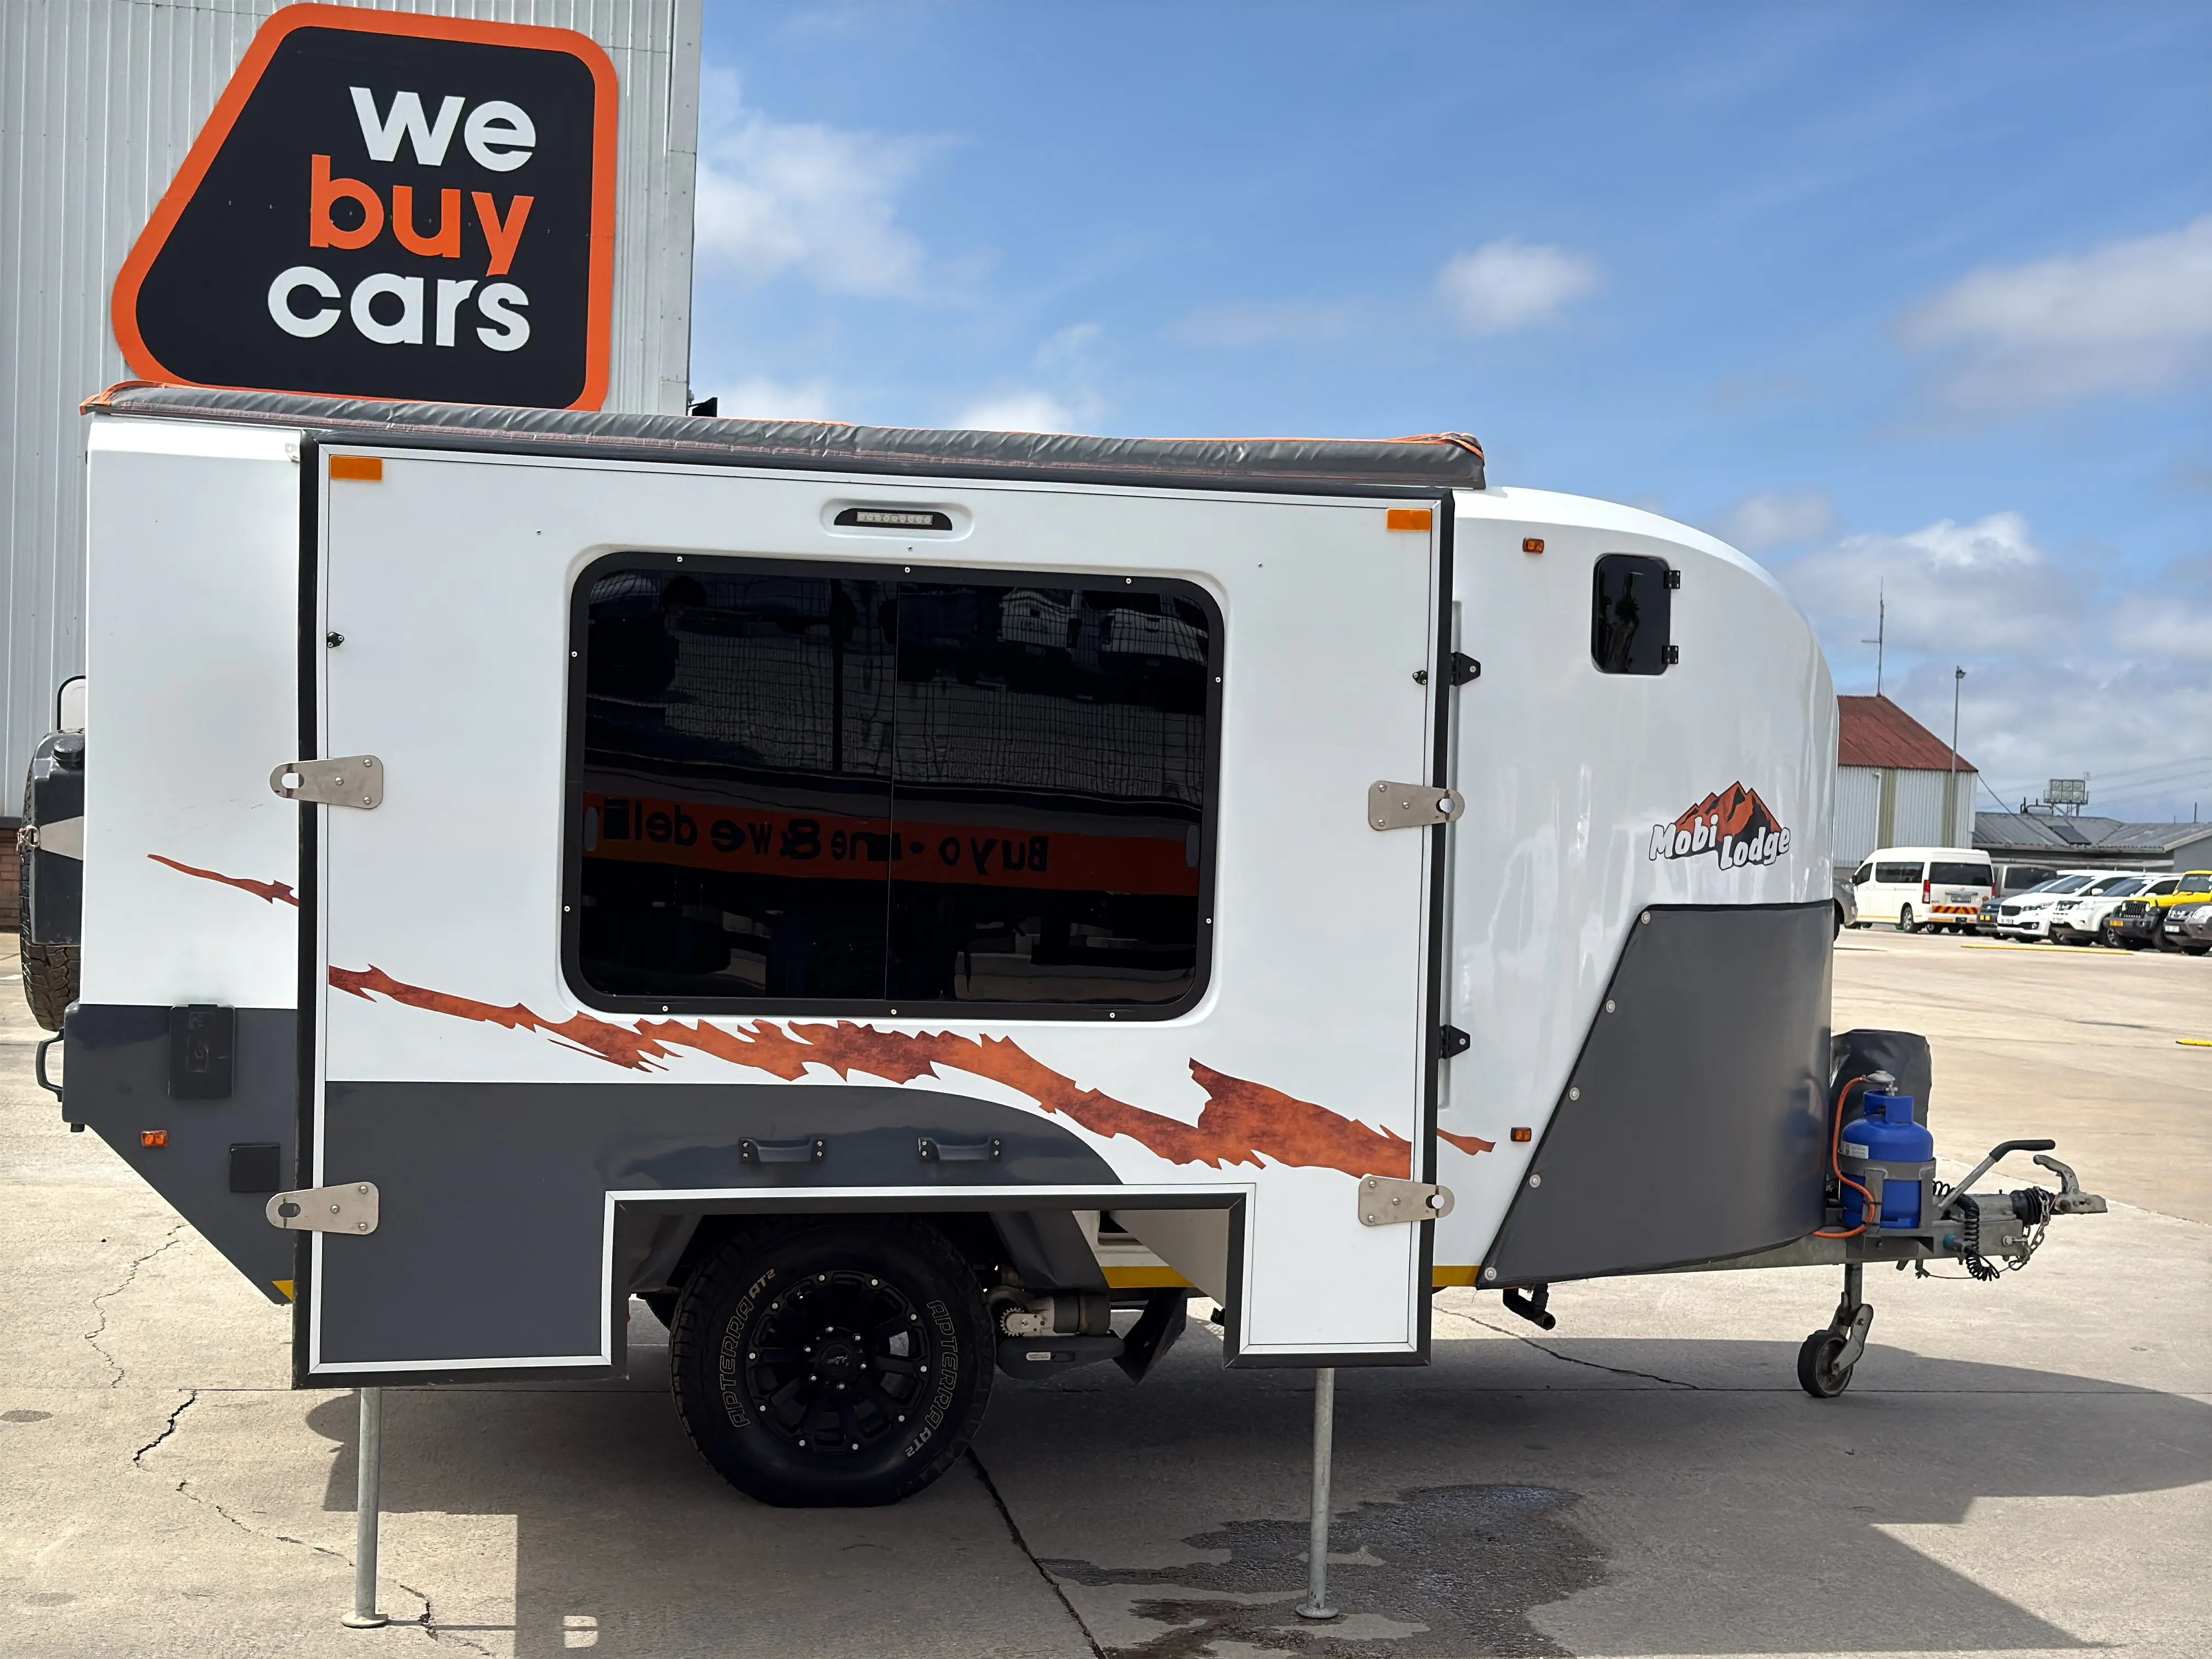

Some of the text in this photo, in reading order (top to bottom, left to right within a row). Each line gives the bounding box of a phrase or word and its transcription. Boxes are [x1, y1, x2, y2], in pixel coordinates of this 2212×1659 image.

[349, 86, 536, 172] we
[309, 154, 534, 276] buy
[268, 266, 530, 352] cars
[1649, 814, 1718, 861] Mobi
[1720, 827, 1790, 870] Lodge
[720, 1296, 754, 1427] APTERRA
[925, 1300, 958, 1430] APTERRA
